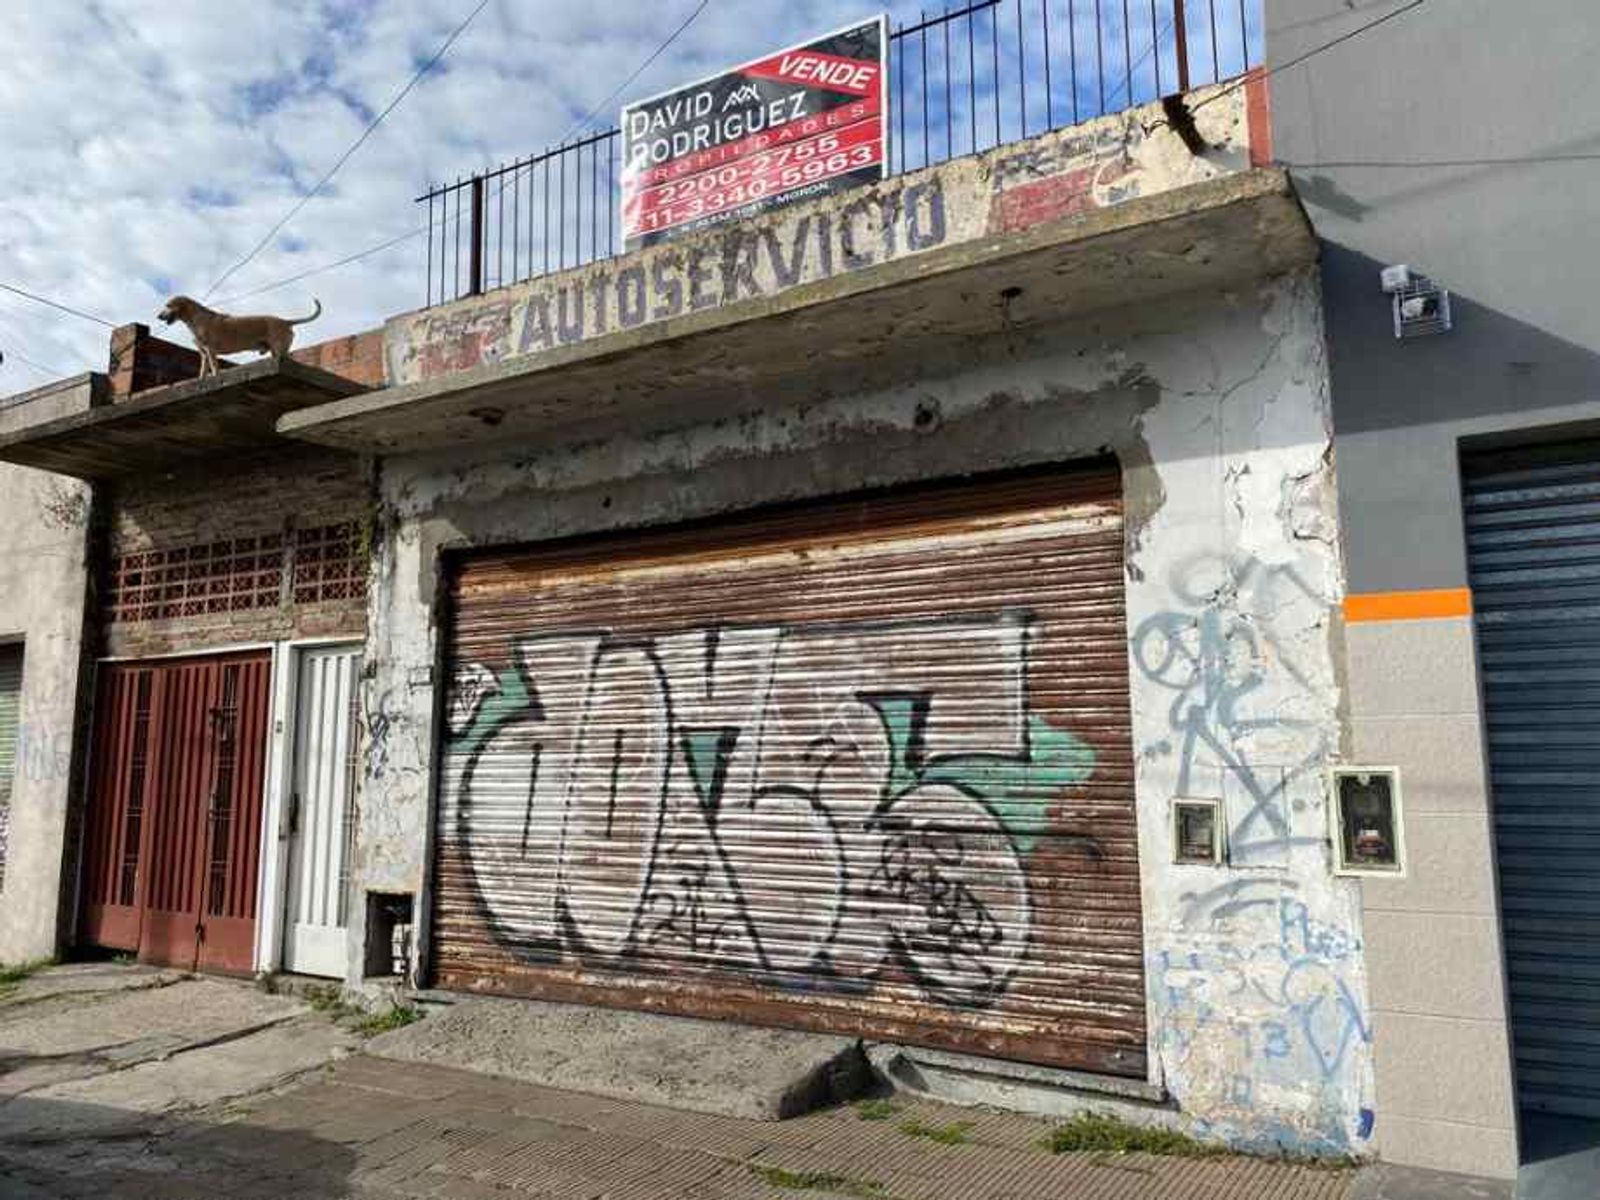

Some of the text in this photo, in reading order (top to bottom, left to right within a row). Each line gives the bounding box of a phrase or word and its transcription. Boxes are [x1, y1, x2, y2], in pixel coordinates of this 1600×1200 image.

[778, 55, 877, 90] VENDE
[630, 91, 714, 141] DAVID
[631, 90, 807, 169] RODRIGUEZ
[645, 144, 873, 228] 11-3340-5963
[658, 134, 840, 205] 2200-2755
[518, 180, 947, 352] AUTOSERVICIO
